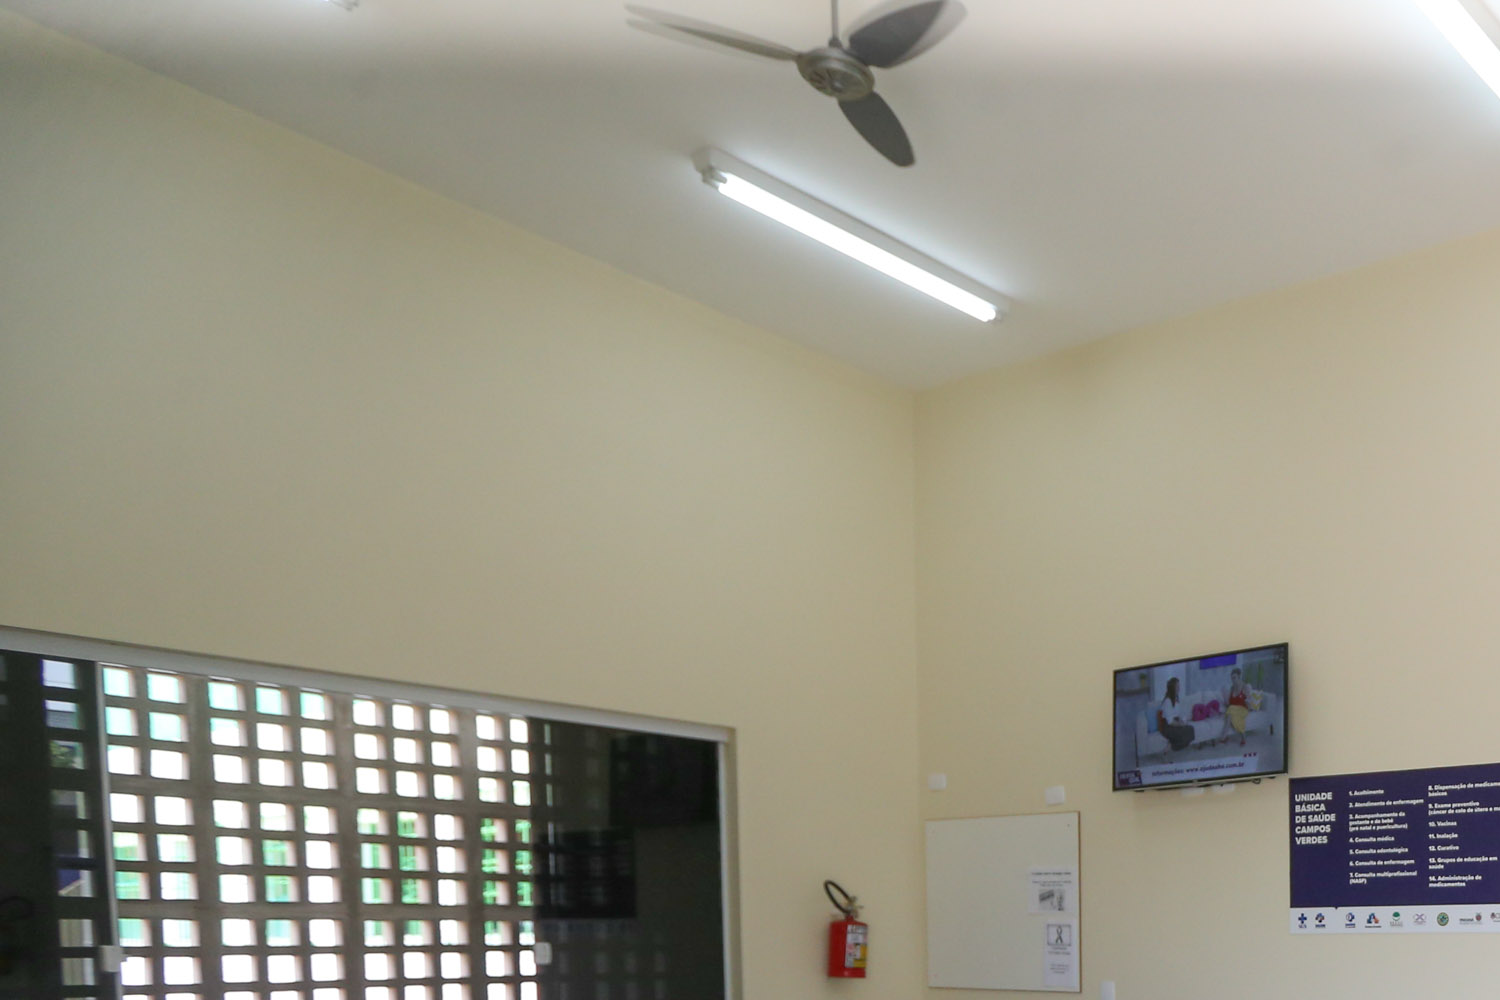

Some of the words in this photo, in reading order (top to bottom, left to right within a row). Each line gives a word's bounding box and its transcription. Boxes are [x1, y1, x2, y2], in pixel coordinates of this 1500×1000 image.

[1295, 792, 1332, 802] UNIDADE
[1295, 803, 1326, 812] BÁSICA
[1296, 815, 1306, 824] DE
[1308, 812, 1336, 822] SAÚDE
[1296, 825, 1331, 834] CAMPOS
[1296, 836, 1328, 845] VERDES
